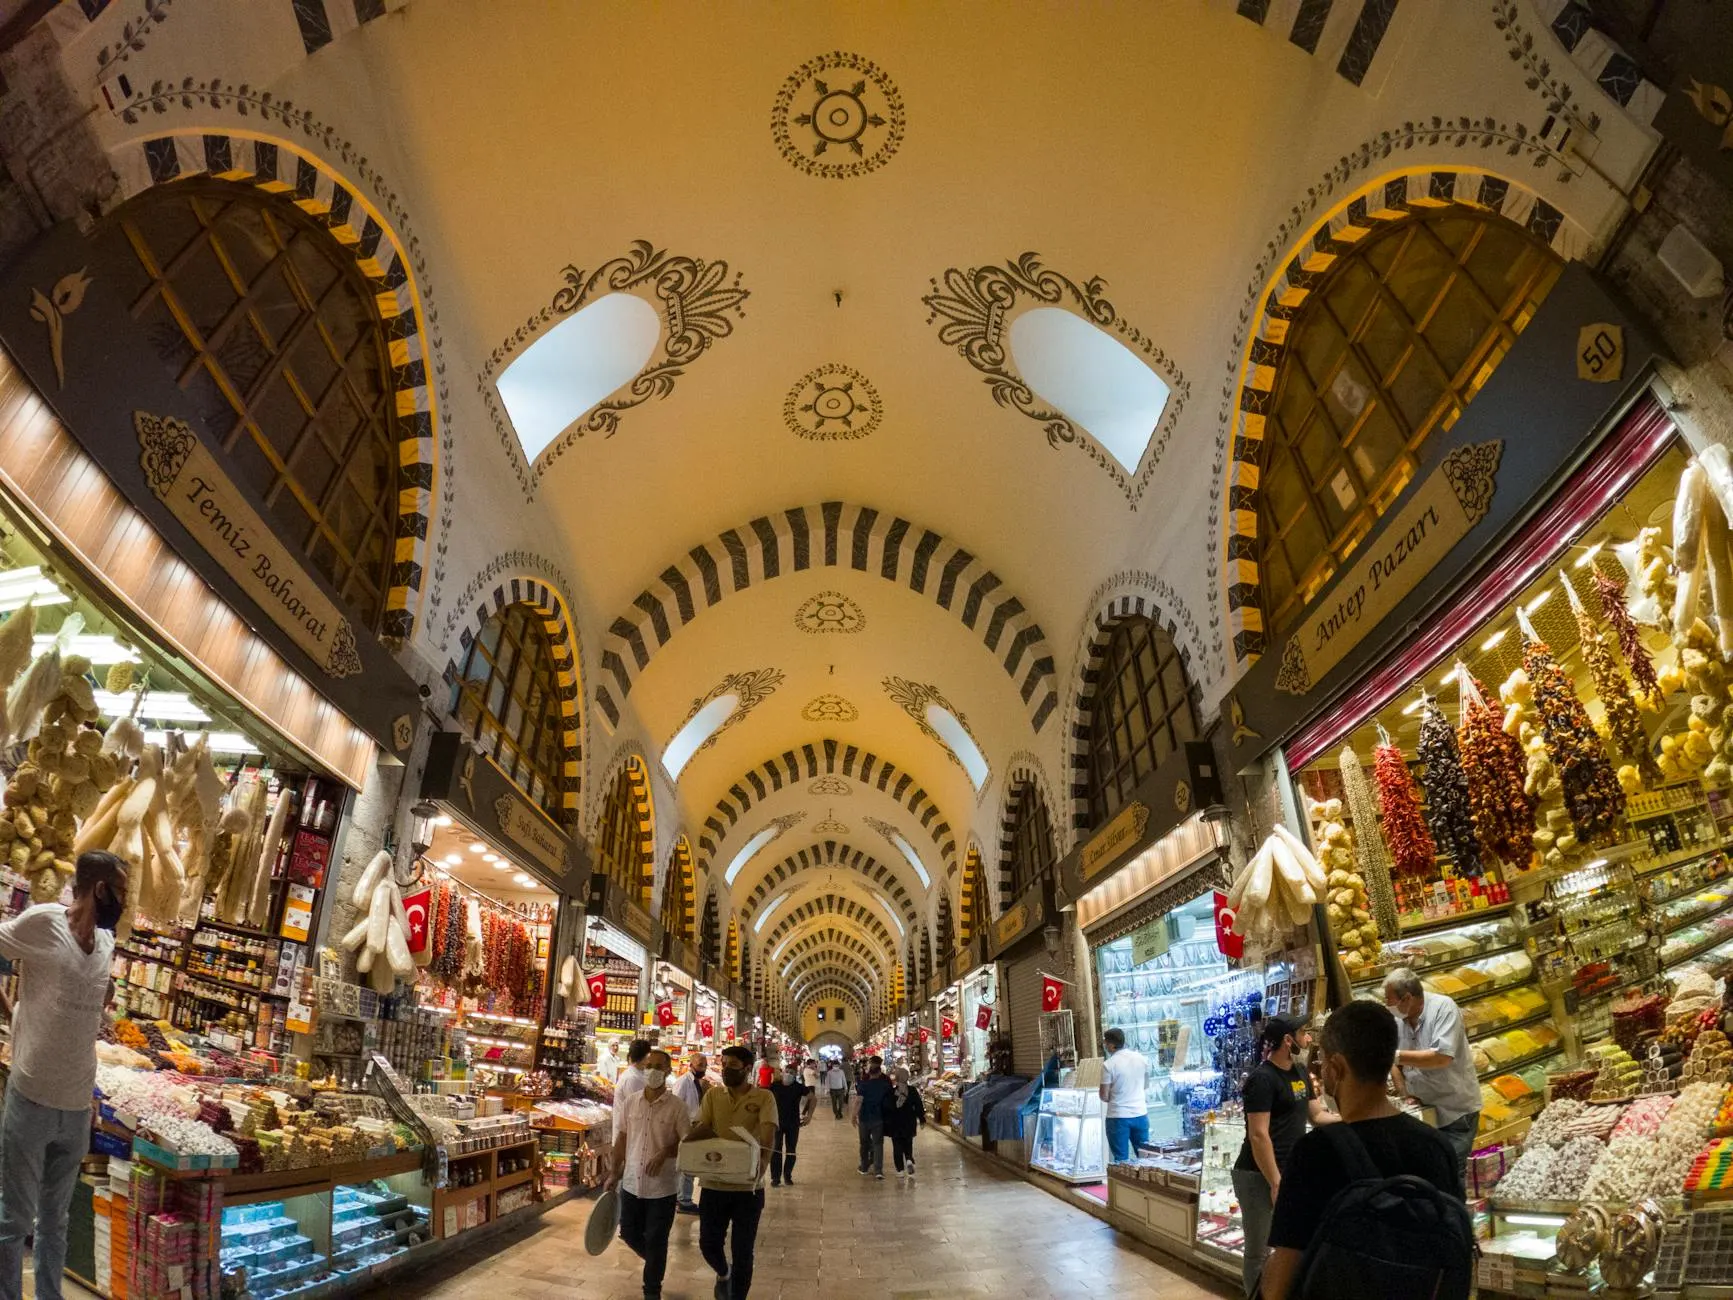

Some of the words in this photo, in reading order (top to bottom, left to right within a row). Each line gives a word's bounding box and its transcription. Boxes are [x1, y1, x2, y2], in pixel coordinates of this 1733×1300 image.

[1581, 331, 1616, 374] 50
[186, 477, 250, 559] Temiz
[252, 553, 327, 643] Baharat
[1315, 583, 1366, 653] Antep
[1367, 503, 1440, 591] Pazarı
[1176, 787, 1187, 805] 52
